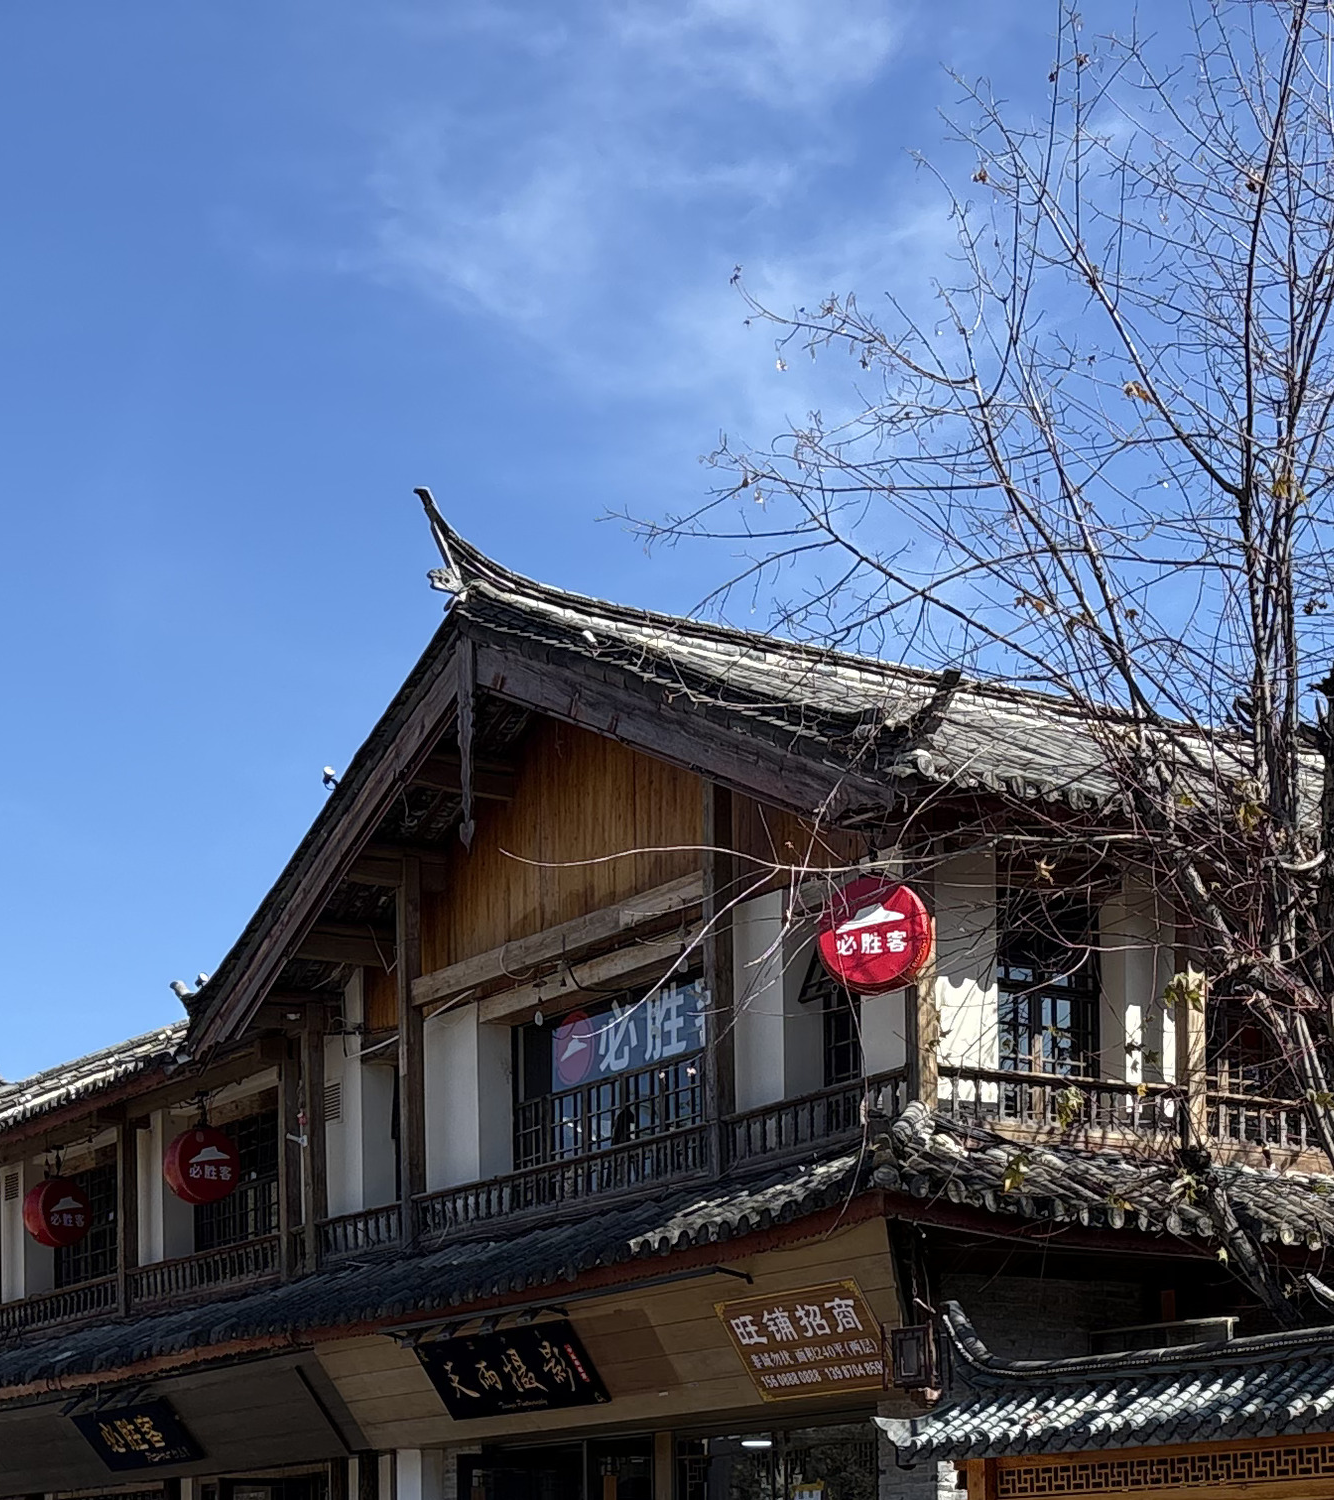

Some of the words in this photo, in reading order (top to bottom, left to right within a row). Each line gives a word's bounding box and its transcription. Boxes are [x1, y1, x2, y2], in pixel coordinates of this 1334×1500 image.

[835, 930, 908, 956] 必胜客
[189, 1164, 233, 1181] 必胜客
[50, 1213, 85, 1228] 必胜客
[729, 1296, 864, 1346] 旺铺招商
[98, 1413, 166, 1454] 必胜客
